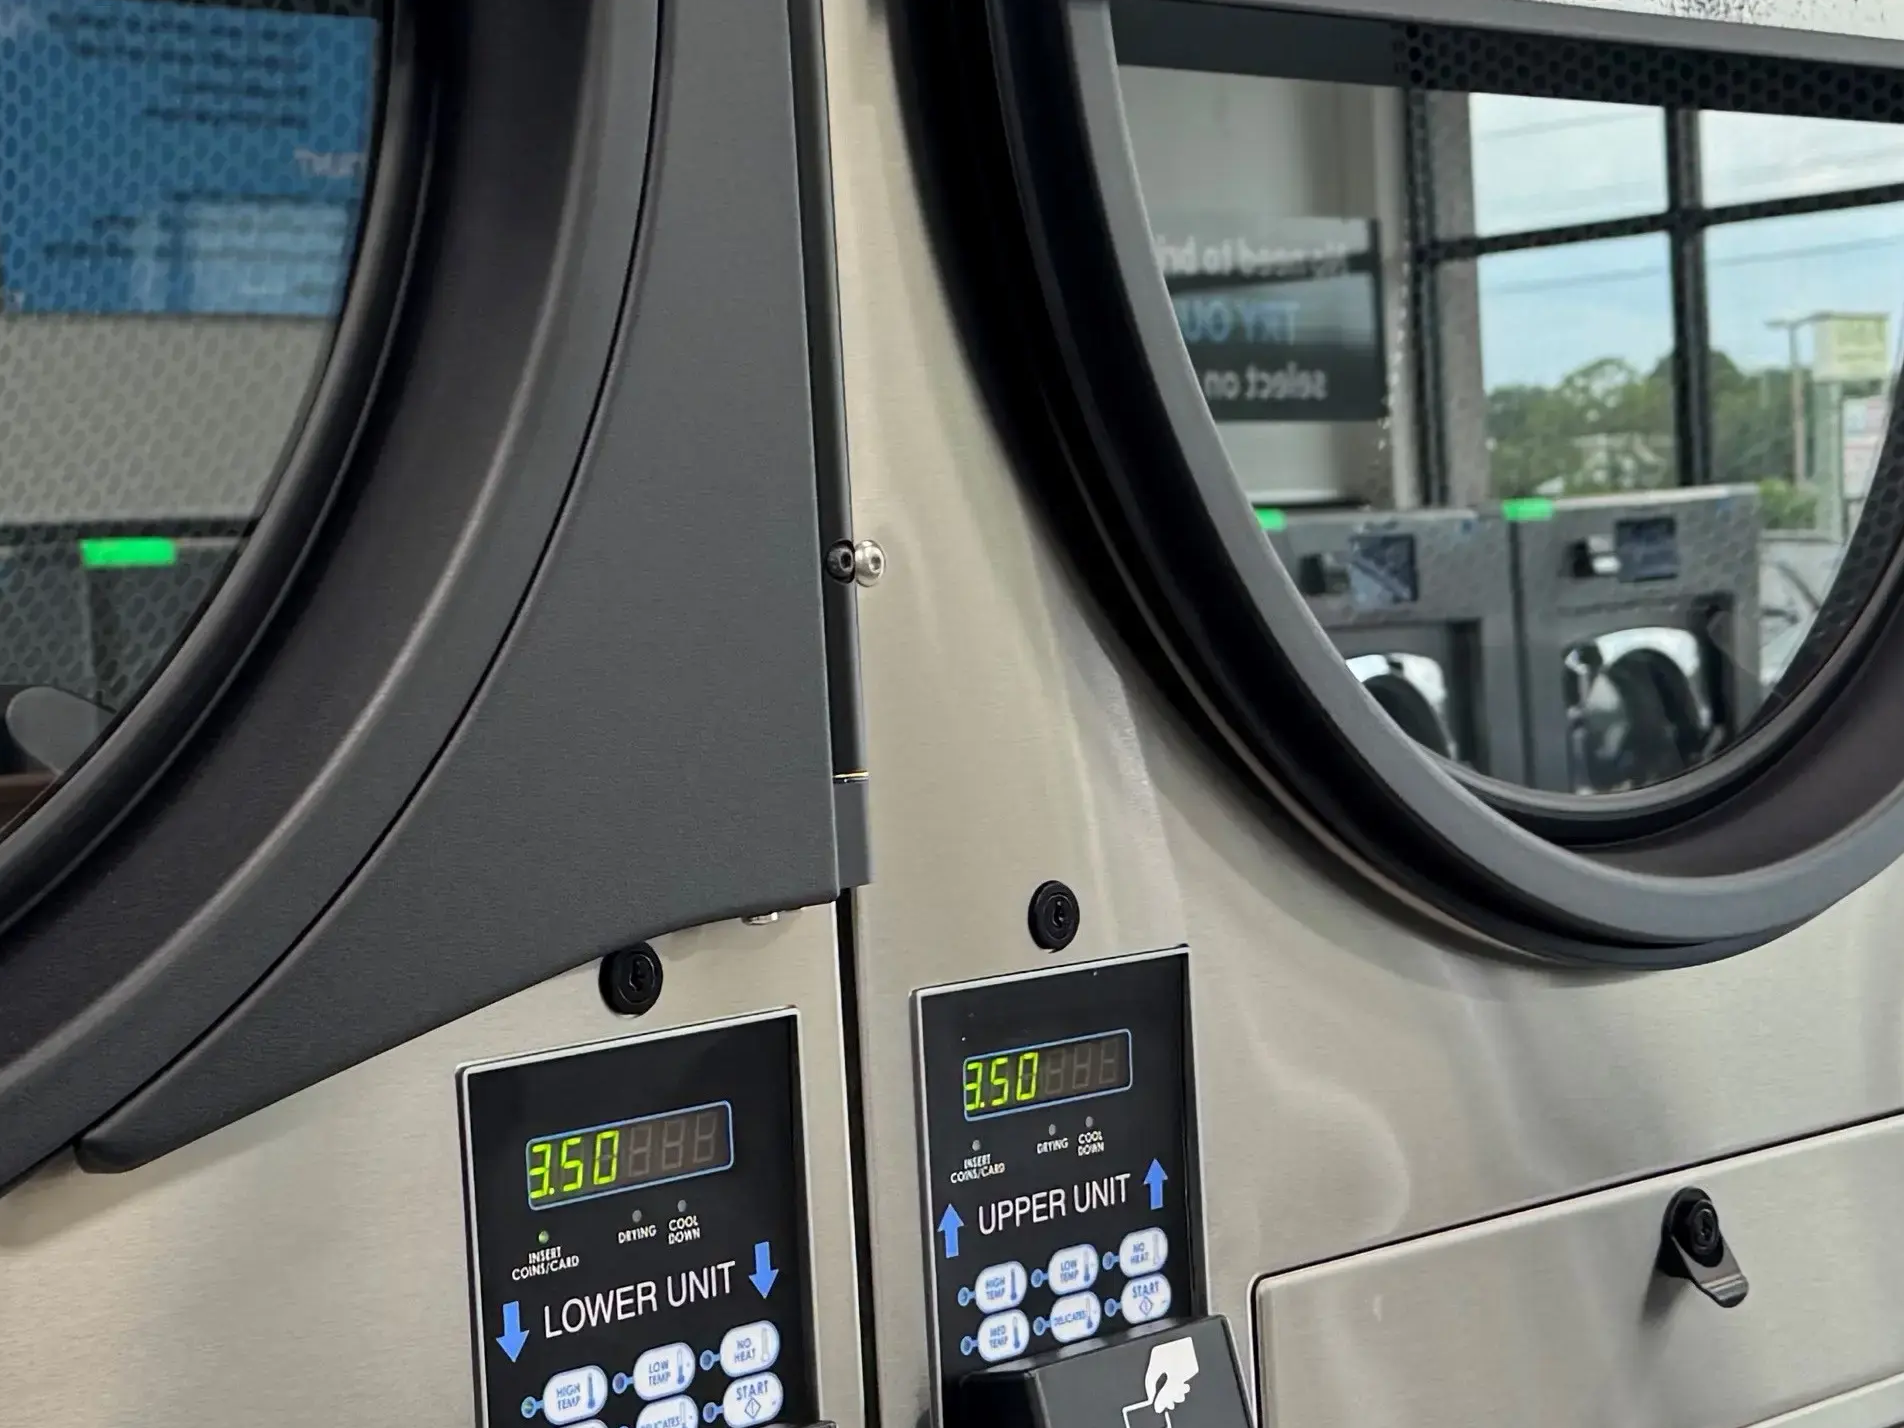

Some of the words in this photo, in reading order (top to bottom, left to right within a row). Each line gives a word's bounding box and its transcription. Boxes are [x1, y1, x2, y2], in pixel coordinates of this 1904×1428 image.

[1078, 1130, 1104, 1146] COOL
[1077, 1141, 1105, 1156] DOWN
[978, 1188, 1066, 1235] UPPER
[1074, 1173, 1131, 1213] UNIT
[668, 1215, 699, 1232] COOL
[618, 1224, 657, 1244] DRYING
[668, 1227, 701, 1245] DOWN
[528, 1246, 562, 1264] INSERT
[511, 1255, 580, 1281] COINS/CARD
[1060, 1259, 1077, 1272] LOW
[1060, 1270, 1079, 1284] TEMP
[1132, 1281, 1160, 1299] START
[544, 1281, 658, 1339] LOWER
[667, 1260, 736, 1308] UNIT
[736, 1337, 752, 1351] NO
[734, 1348, 756, 1364] HEAT
[648, 1359, 670, 1373] LOW
[648, 1371, 672, 1387] TEMP
[556, 1381, 581, 1398] HIGH
[736, 1380, 768, 1401] START
[557, 1396, 581, 1412] TEMP
